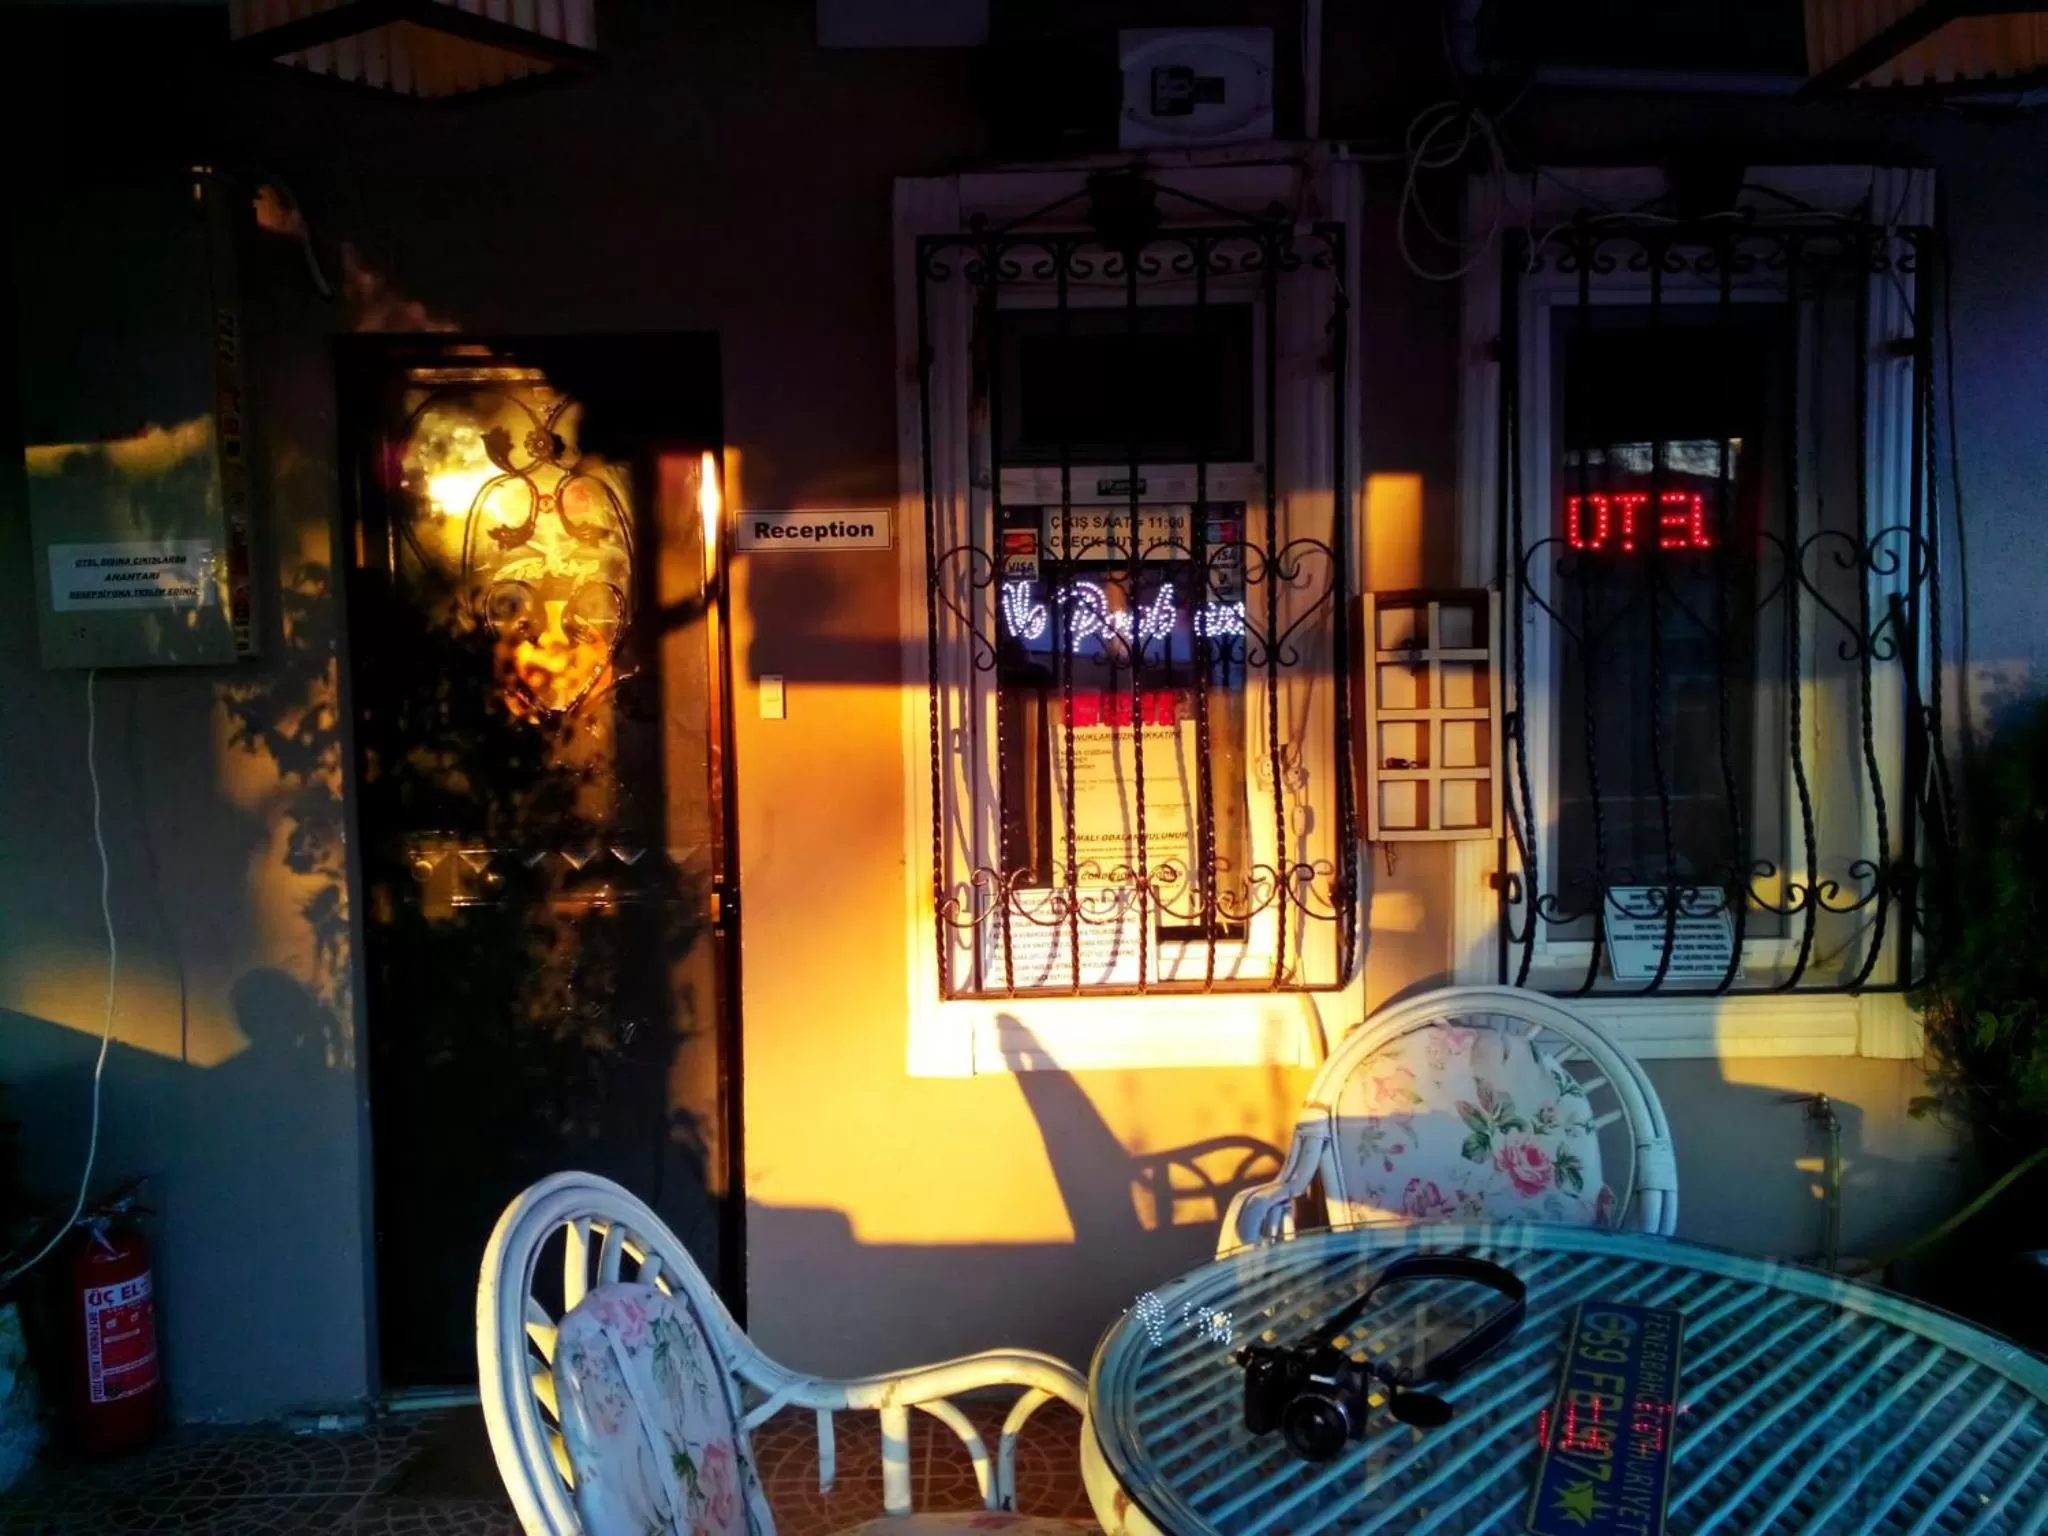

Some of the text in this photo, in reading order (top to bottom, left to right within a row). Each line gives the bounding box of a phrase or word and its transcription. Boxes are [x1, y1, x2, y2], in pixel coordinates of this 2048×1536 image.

[1050, 516, 1088, 530] ÇKIŞ
[755, 521, 874, 541] Reception
[1050, 536, 1102, 548] CECK
[1007, 561, 1035, 573] VISA
